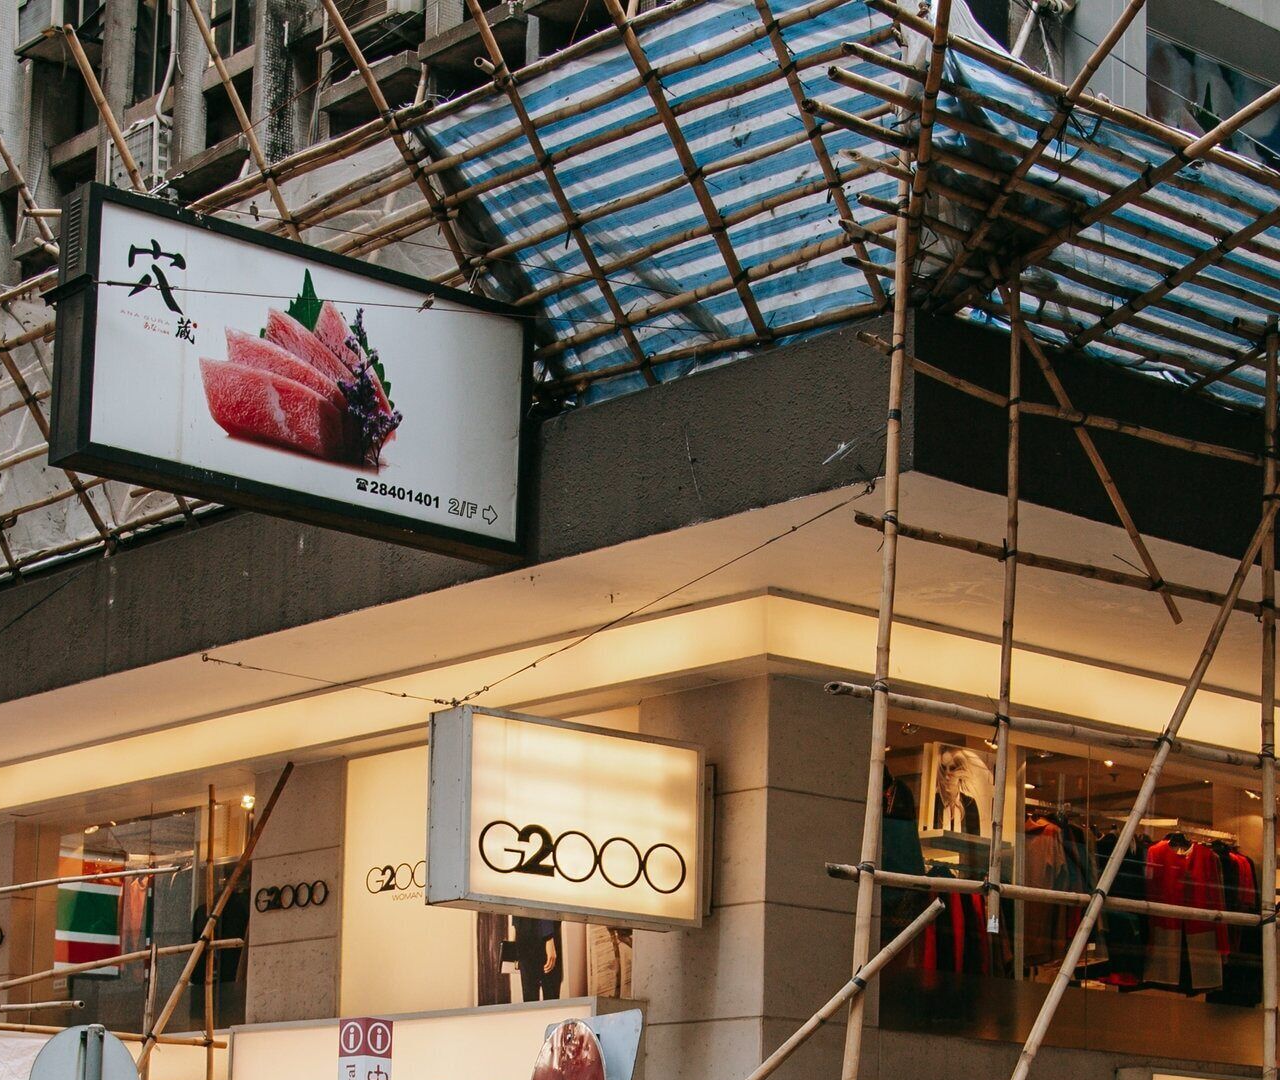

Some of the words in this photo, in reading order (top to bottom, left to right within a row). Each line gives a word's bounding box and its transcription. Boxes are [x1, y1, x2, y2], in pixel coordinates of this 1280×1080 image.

[127, 238, 187, 316] 穴
[370, 480, 441, 510] 28401401
[447, 497, 478, 521] 2/F
[365, 858, 427, 895] G200
[478, 819, 687, 895] G2000
[254, 878, 329, 913] G2000
